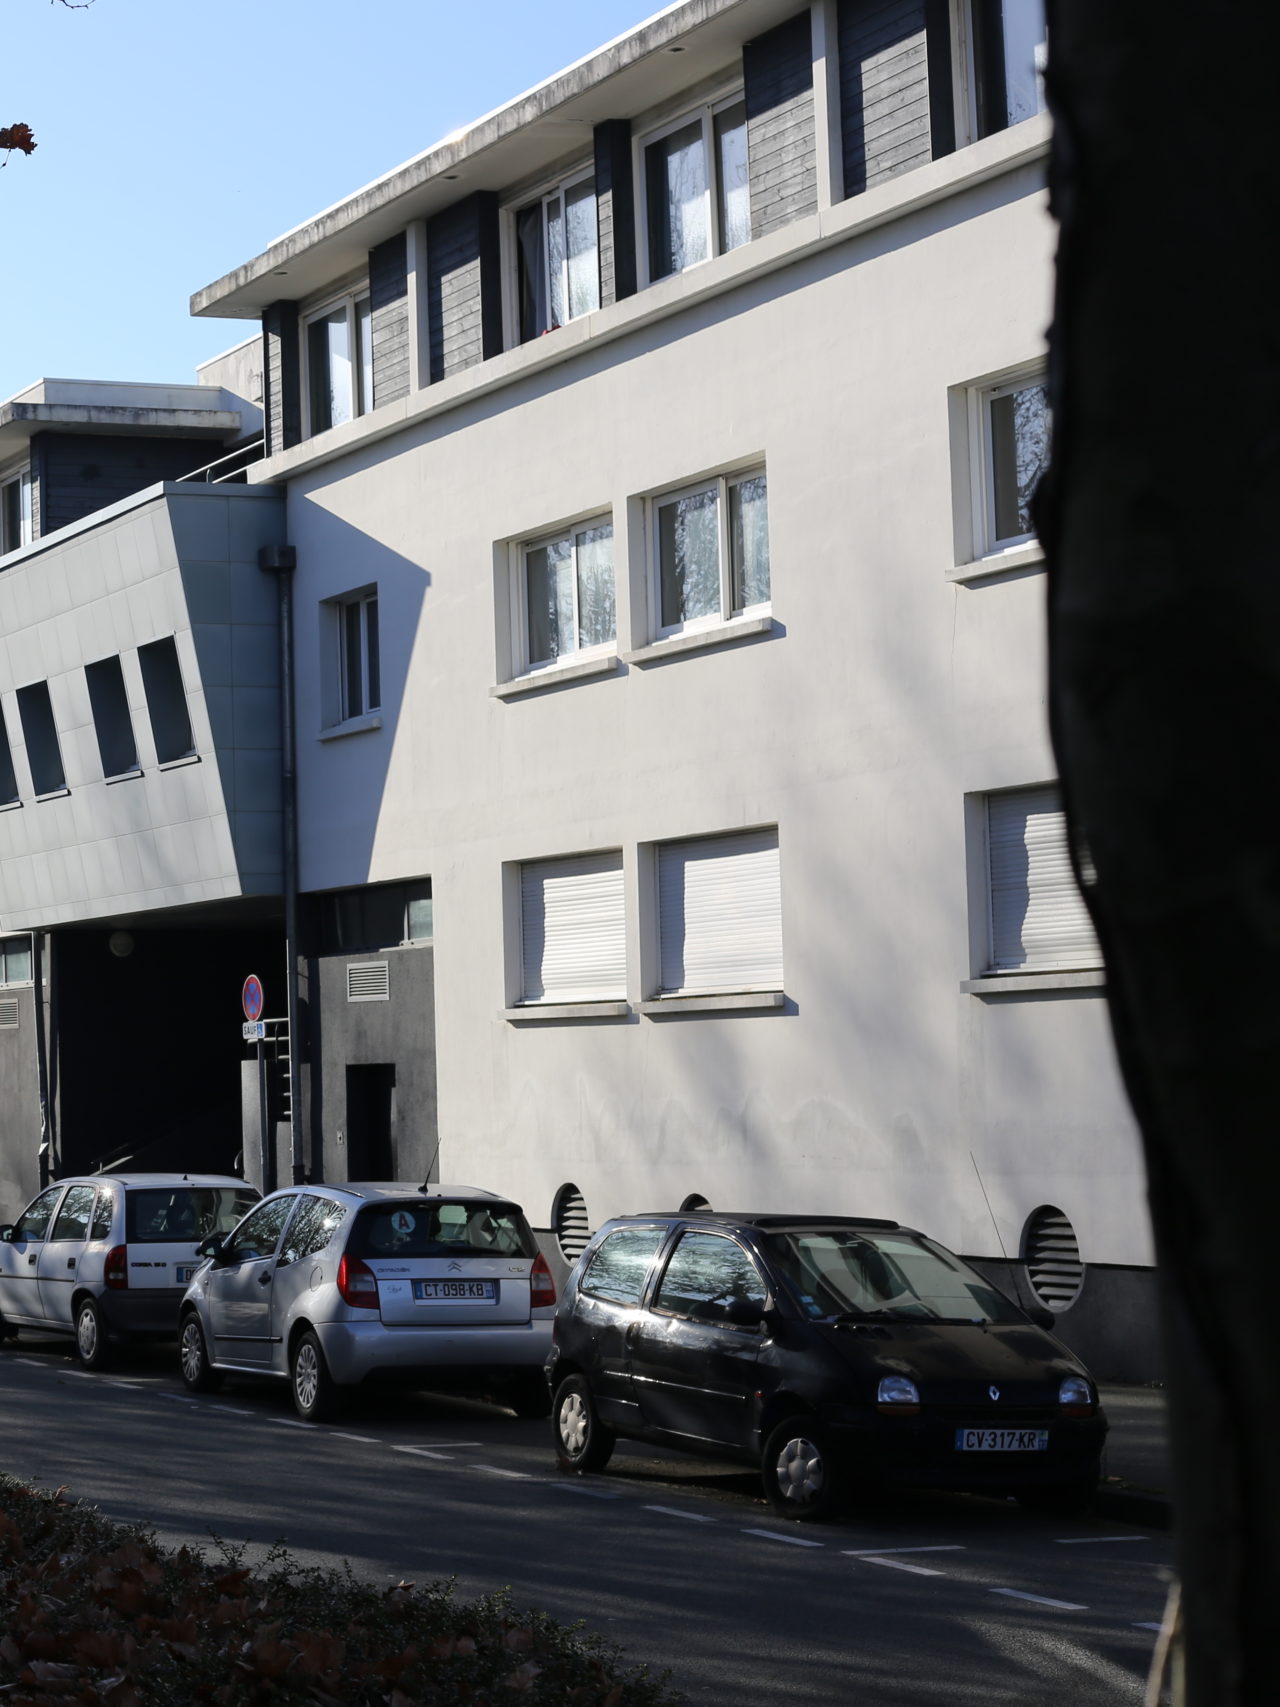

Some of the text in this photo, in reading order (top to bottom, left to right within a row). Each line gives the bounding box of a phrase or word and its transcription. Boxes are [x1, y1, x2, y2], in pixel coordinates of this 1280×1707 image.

[244, 1025, 256, 1035] SAUF
[398, 1213, 411, 1229] A
[424, 1283, 484, 1297] CT-098-KB
[966, 1431, 1037, 1448] CV-317-KR
